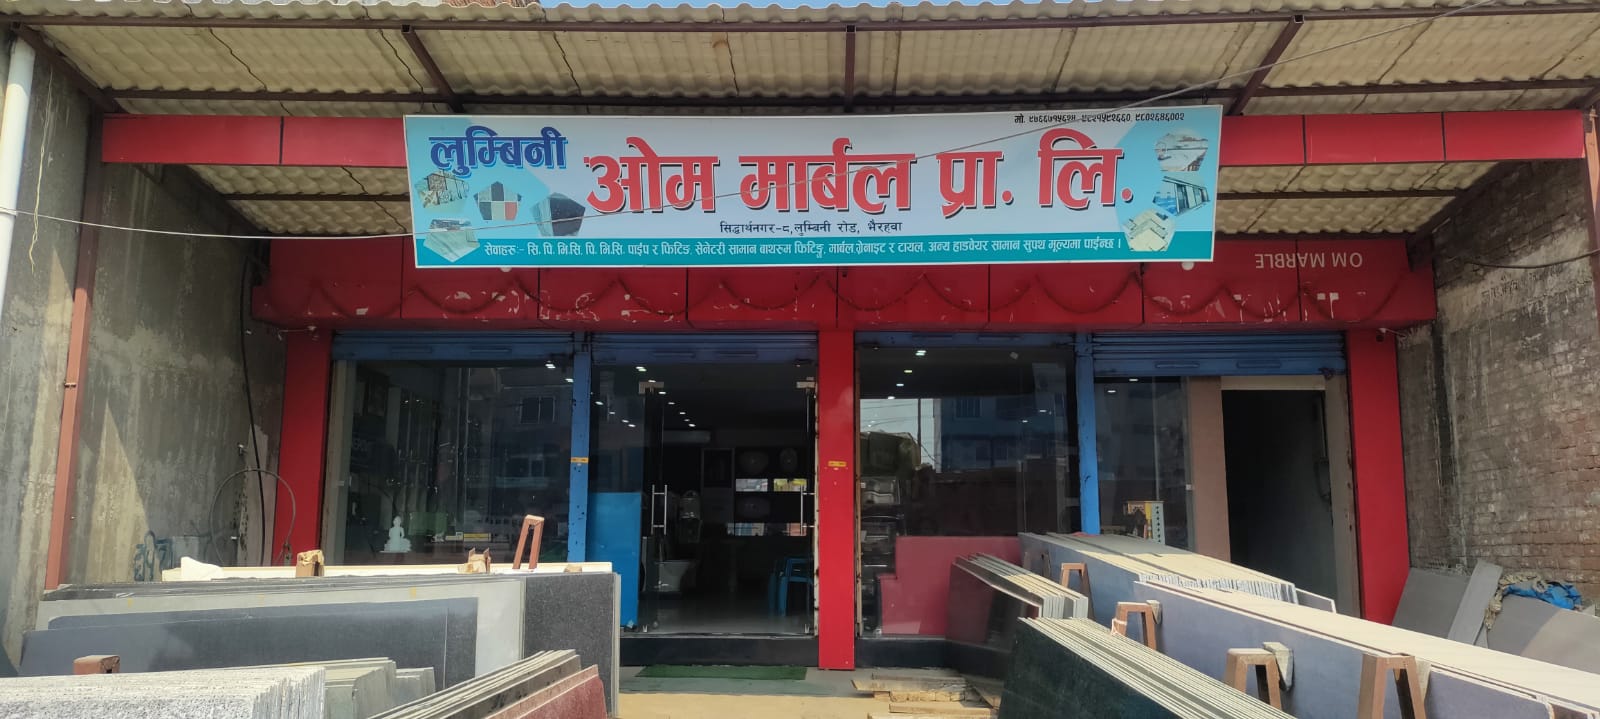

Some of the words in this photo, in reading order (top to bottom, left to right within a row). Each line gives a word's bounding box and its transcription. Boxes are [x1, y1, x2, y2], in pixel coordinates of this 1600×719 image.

[429, 126, 568, 178] लुम्बिनी
[583, 136, 720, 213] ओम
[738, 137, 917, 213] मार्बल
[936, 150, 1014, 218] प्रा.
[1037, 127, 1133, 208] लि.
[837, 221, 860, 234] रोड,
[867, 219, 903, 234] भैरहवा
[652, 244, 659, 255] र
[728, 243, 757, 255] सामान
[888, 242, 895, 253] र
[928, 241, 950, 252] अन्य
[991, 240, 1020, 251] सामान
[1023, 239, 1046, 253] सुपथ
[1048, 239, 1081, 253] मूल्यमा
[1254, 252, 1325, 269] MARBLE
[1331, 252, 1363, 268] OM
